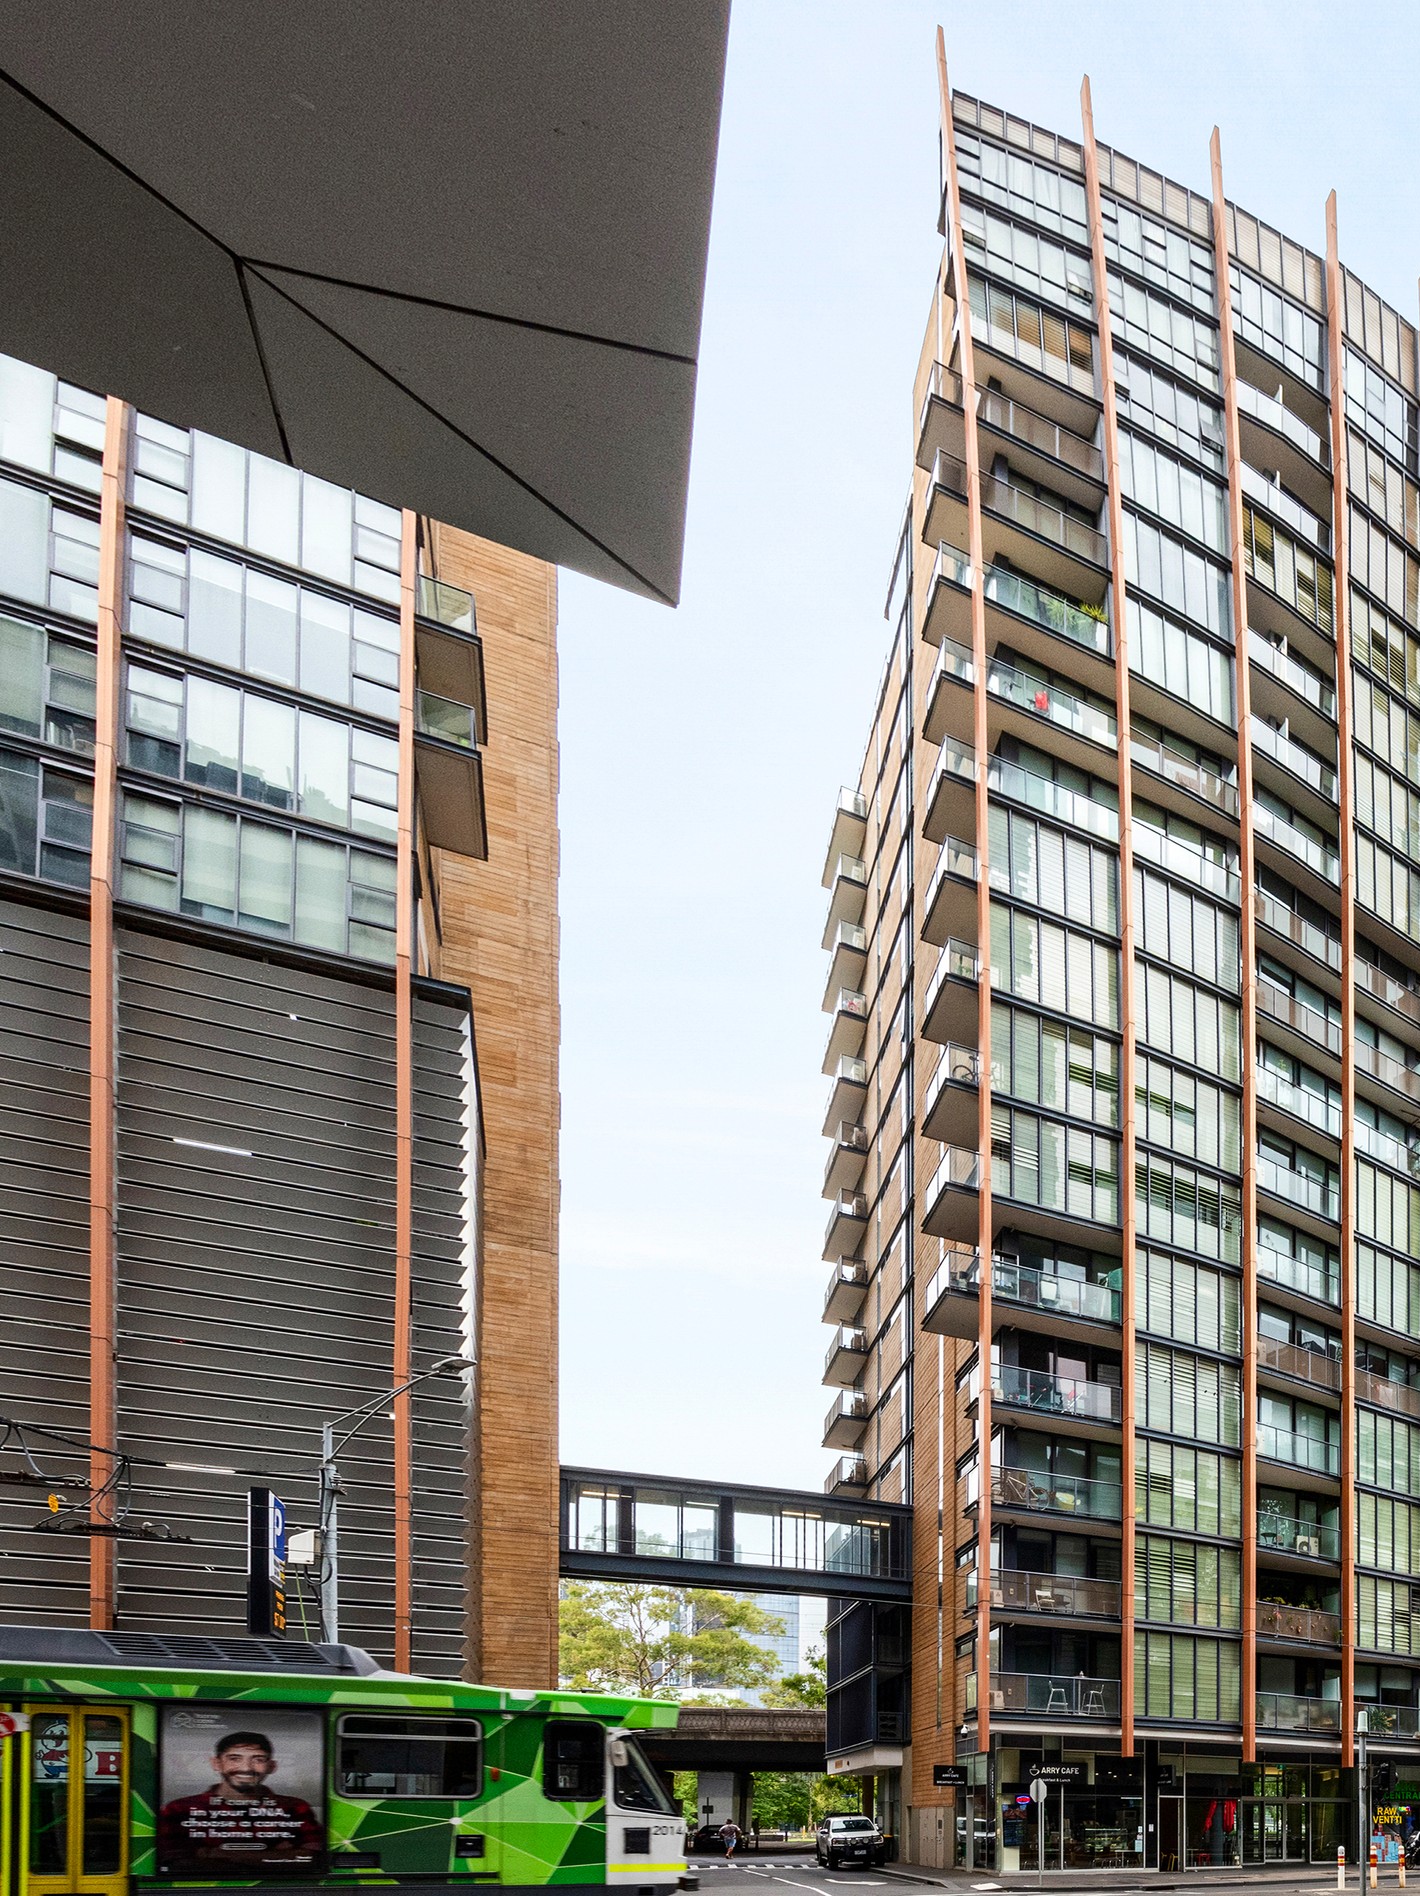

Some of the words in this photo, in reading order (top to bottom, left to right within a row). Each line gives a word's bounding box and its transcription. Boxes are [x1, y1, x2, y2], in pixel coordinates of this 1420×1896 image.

[275, 1508, 282, 1548] P
[262, 1797, 277, 1806] is
[190, 1807, 207, 1816] in
[209, 1809, 247, 1819] your
[1377, 1807, 1397, 1815] RAW
[180, 1818, 237, 1828] choose
[239, 1820, 252, 1828] a
[253, 1820, 304, 1828] career
[1372, 1815, 1402, 1824] VENTTI
[189, 1829, 207, 1838] in
[208, 1829, 253, 1838] home
[652, 1825, 684, 1836] 2014
